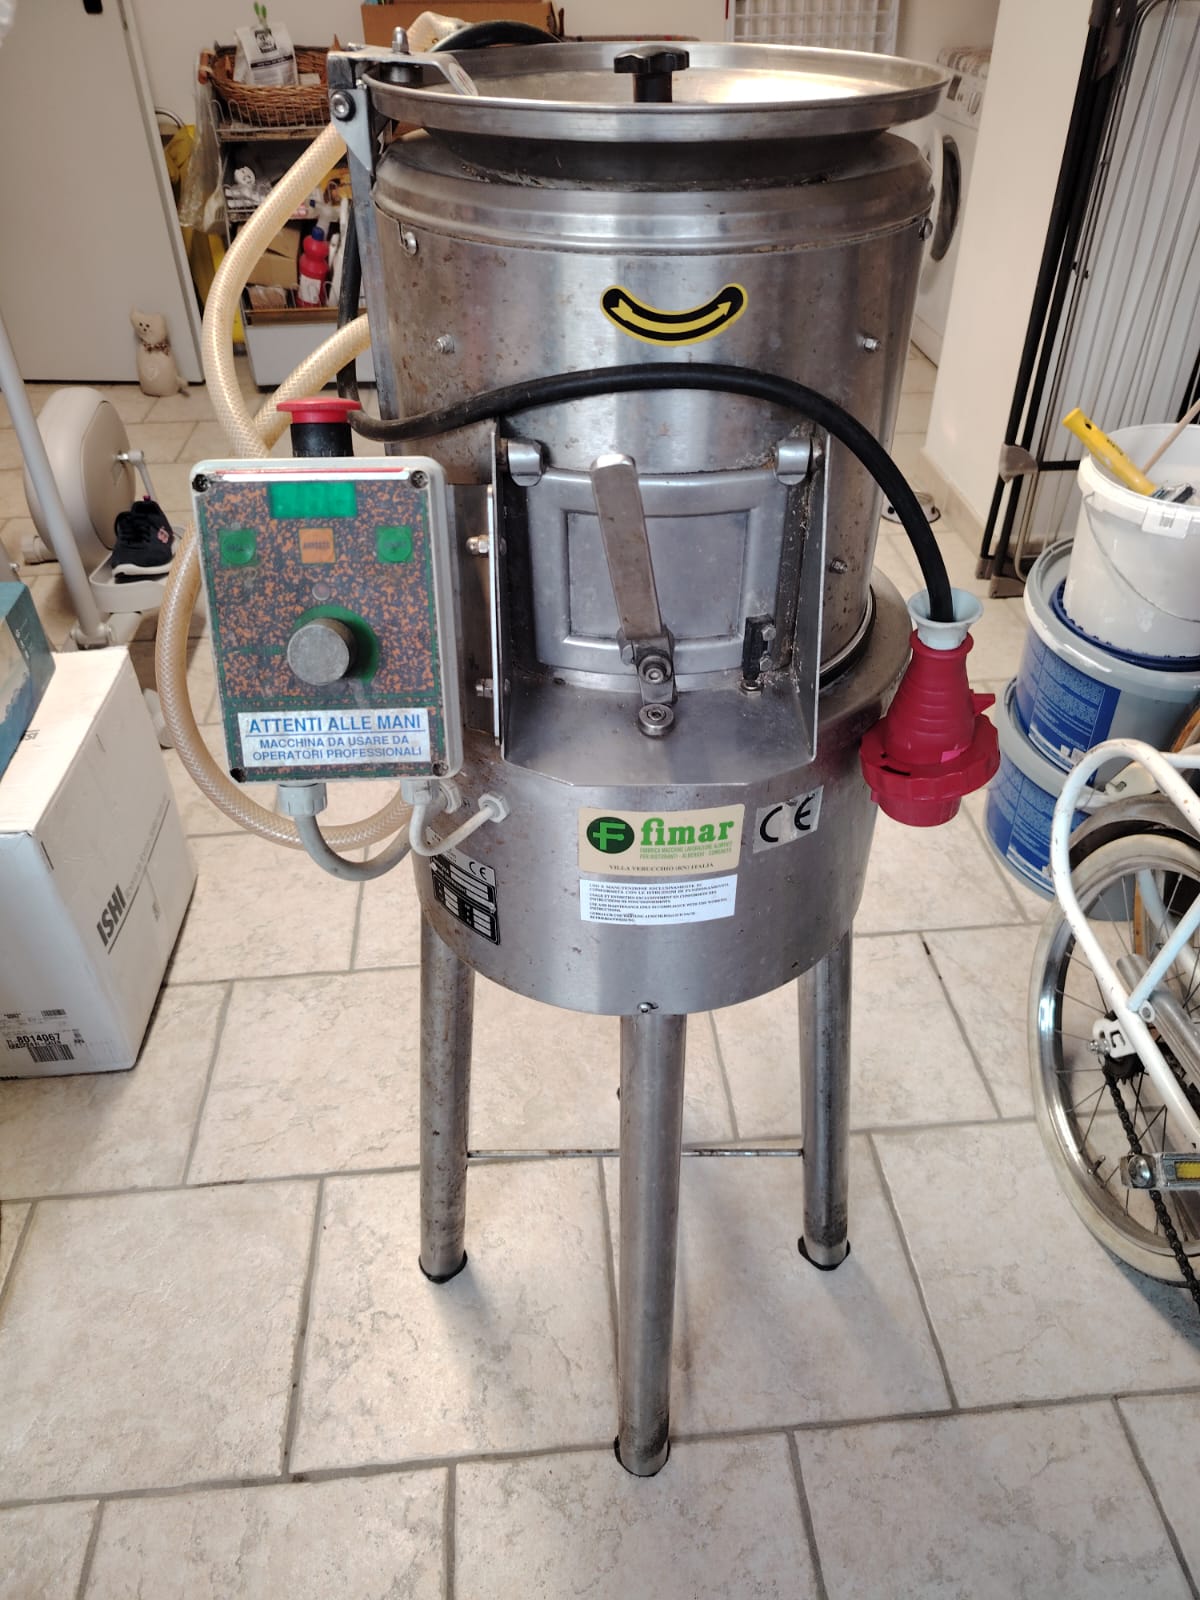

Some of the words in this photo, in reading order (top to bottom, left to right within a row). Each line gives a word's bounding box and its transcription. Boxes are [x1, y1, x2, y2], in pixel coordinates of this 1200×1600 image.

[249, 717, 321, 734] ATTENTI
[328, 715, 372, 732] ALLE
[377, 714, 421, 730] MANI
[260, 736, 324, 749] MACCHINA
[328, 736, 345, 747] DA
[348, 735, 389, 747] USARE
[392, 735, 409, 745] DA
[252, 749, 323, 761] OPERATORI
[327, 746, 422, 760] PROFESSIONALI
[640, 817, 735, 846] fimar
